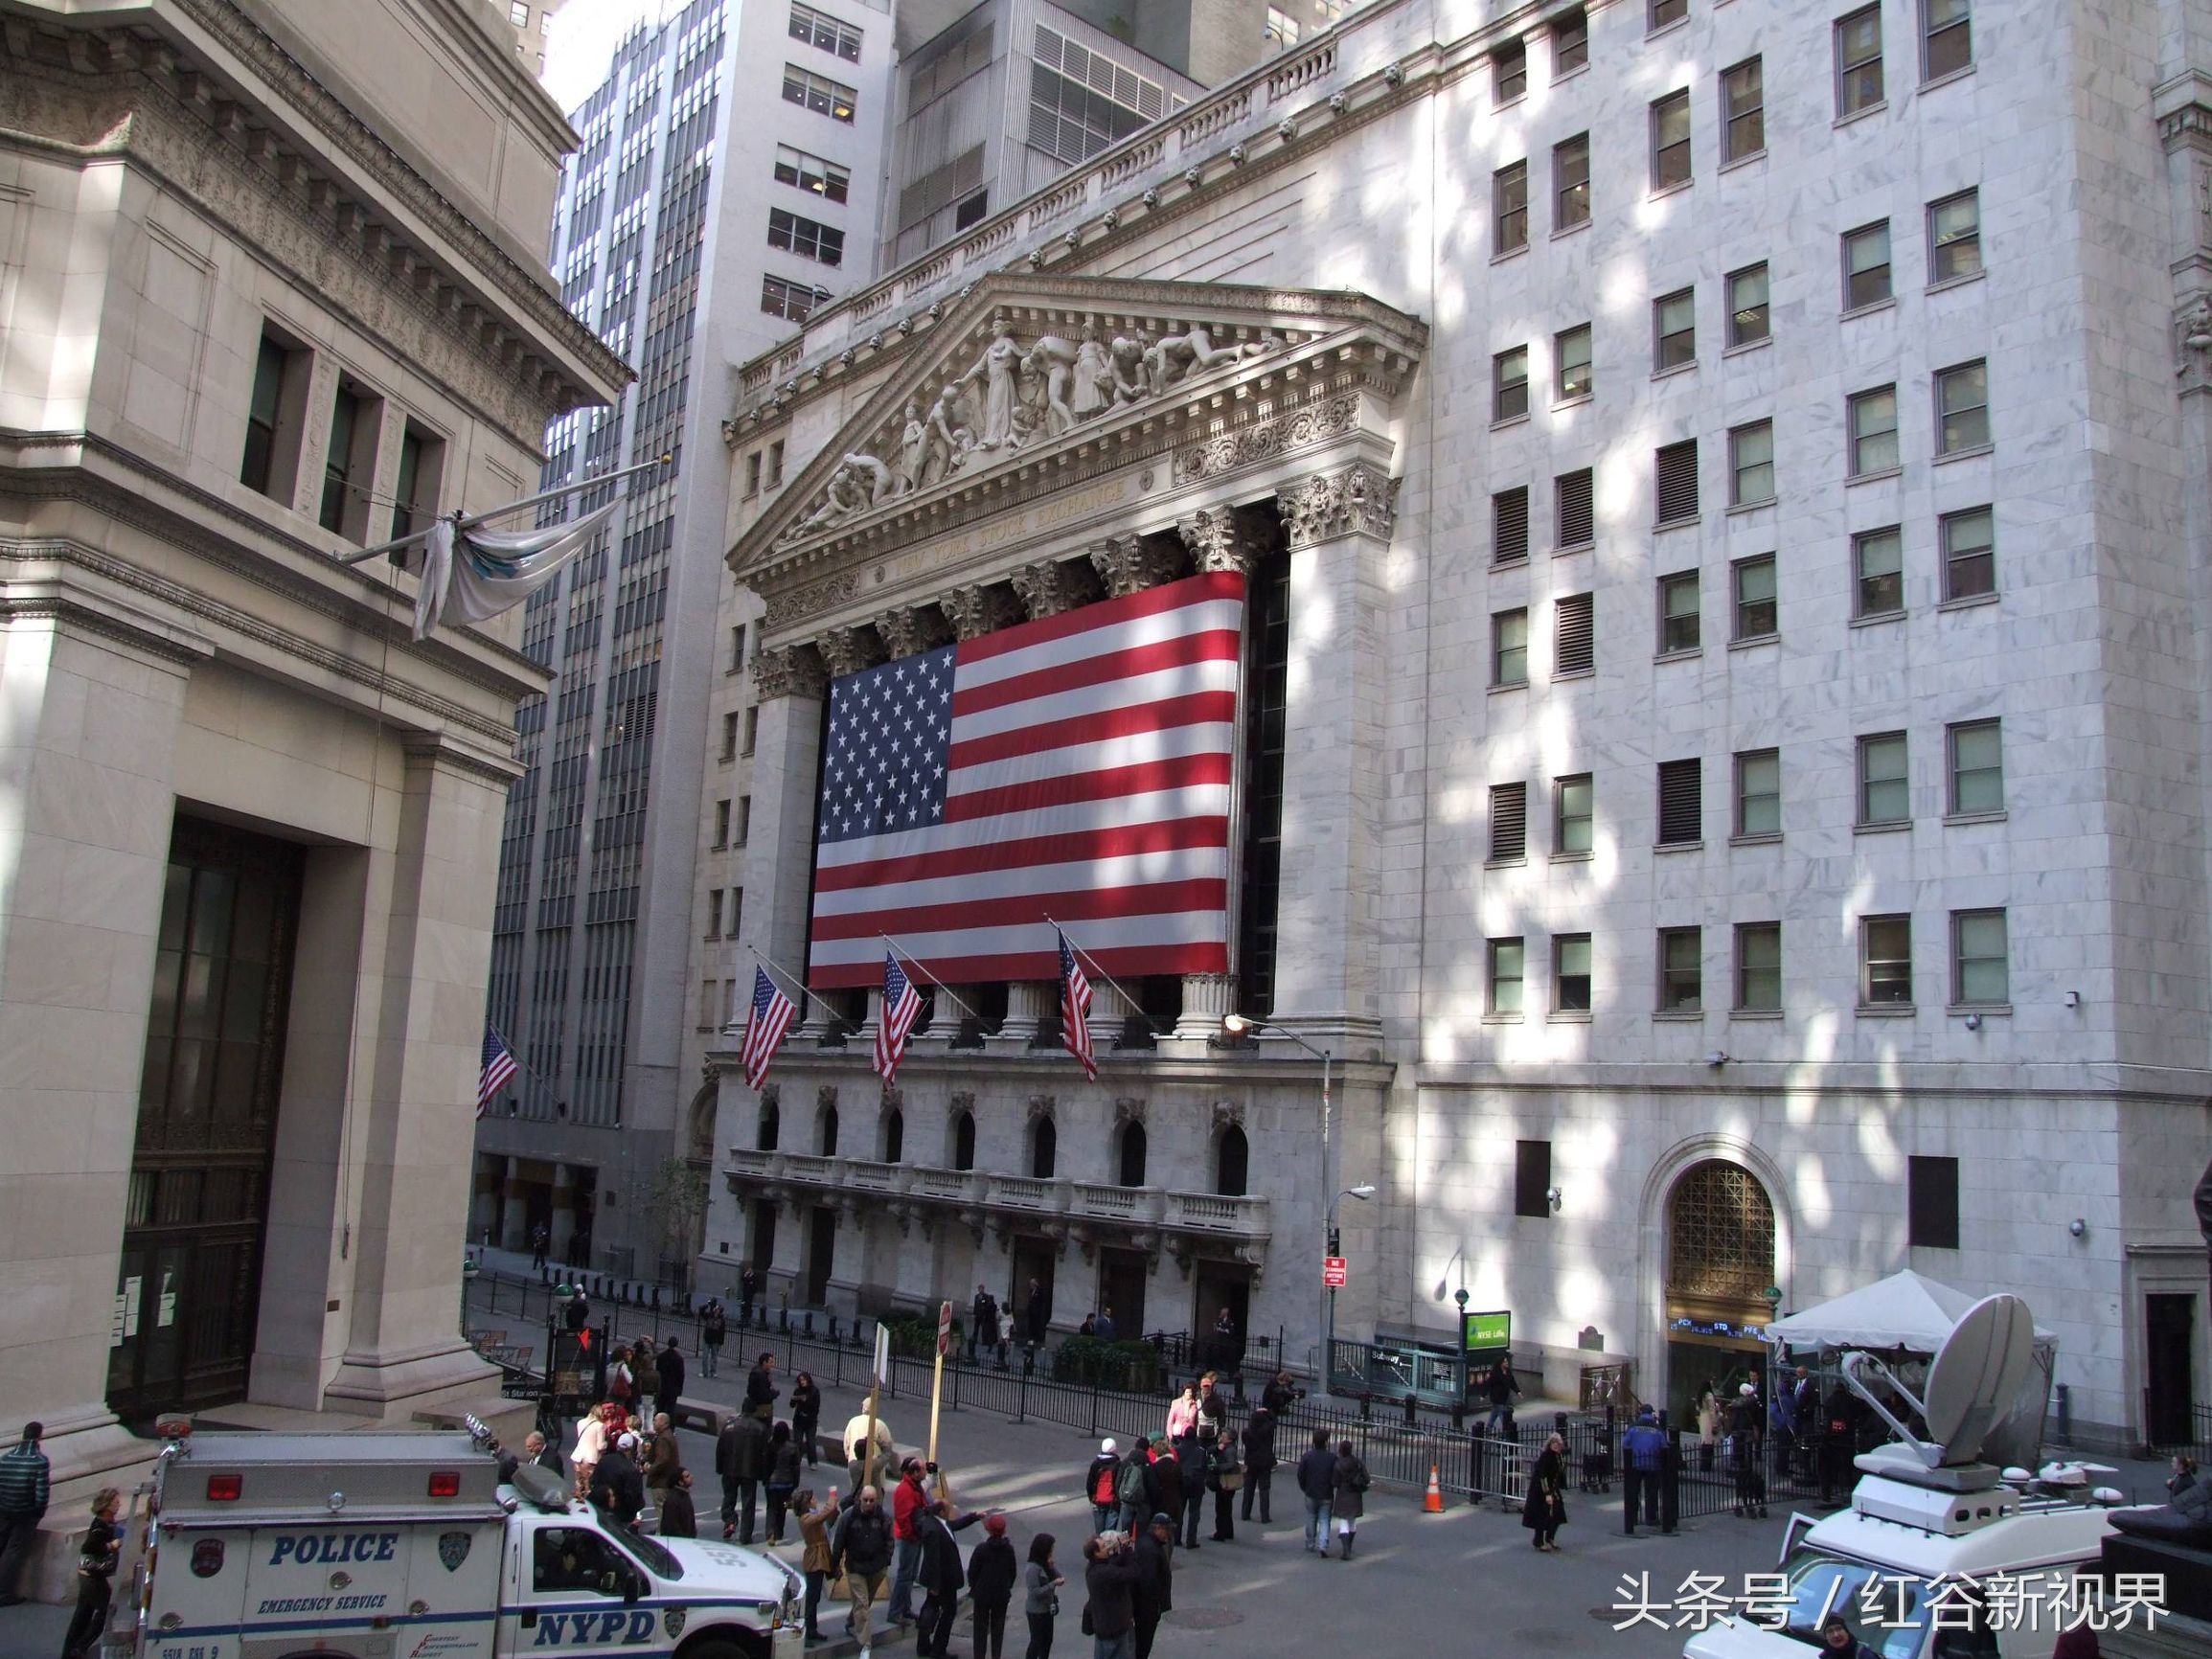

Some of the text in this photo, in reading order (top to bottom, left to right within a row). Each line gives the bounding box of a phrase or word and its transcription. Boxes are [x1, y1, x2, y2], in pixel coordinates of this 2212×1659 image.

[895, 481, 1126, 572] NEW YORK STOCK EXCHANGE
[1372, 1351, 1400, 1363] Subway
[269, 1533, 399, 1566] POLICE
[258, 1594, 387, 1615] EMERGENCY SERVICE
[534, 1610, 656, 1647] NYPD
